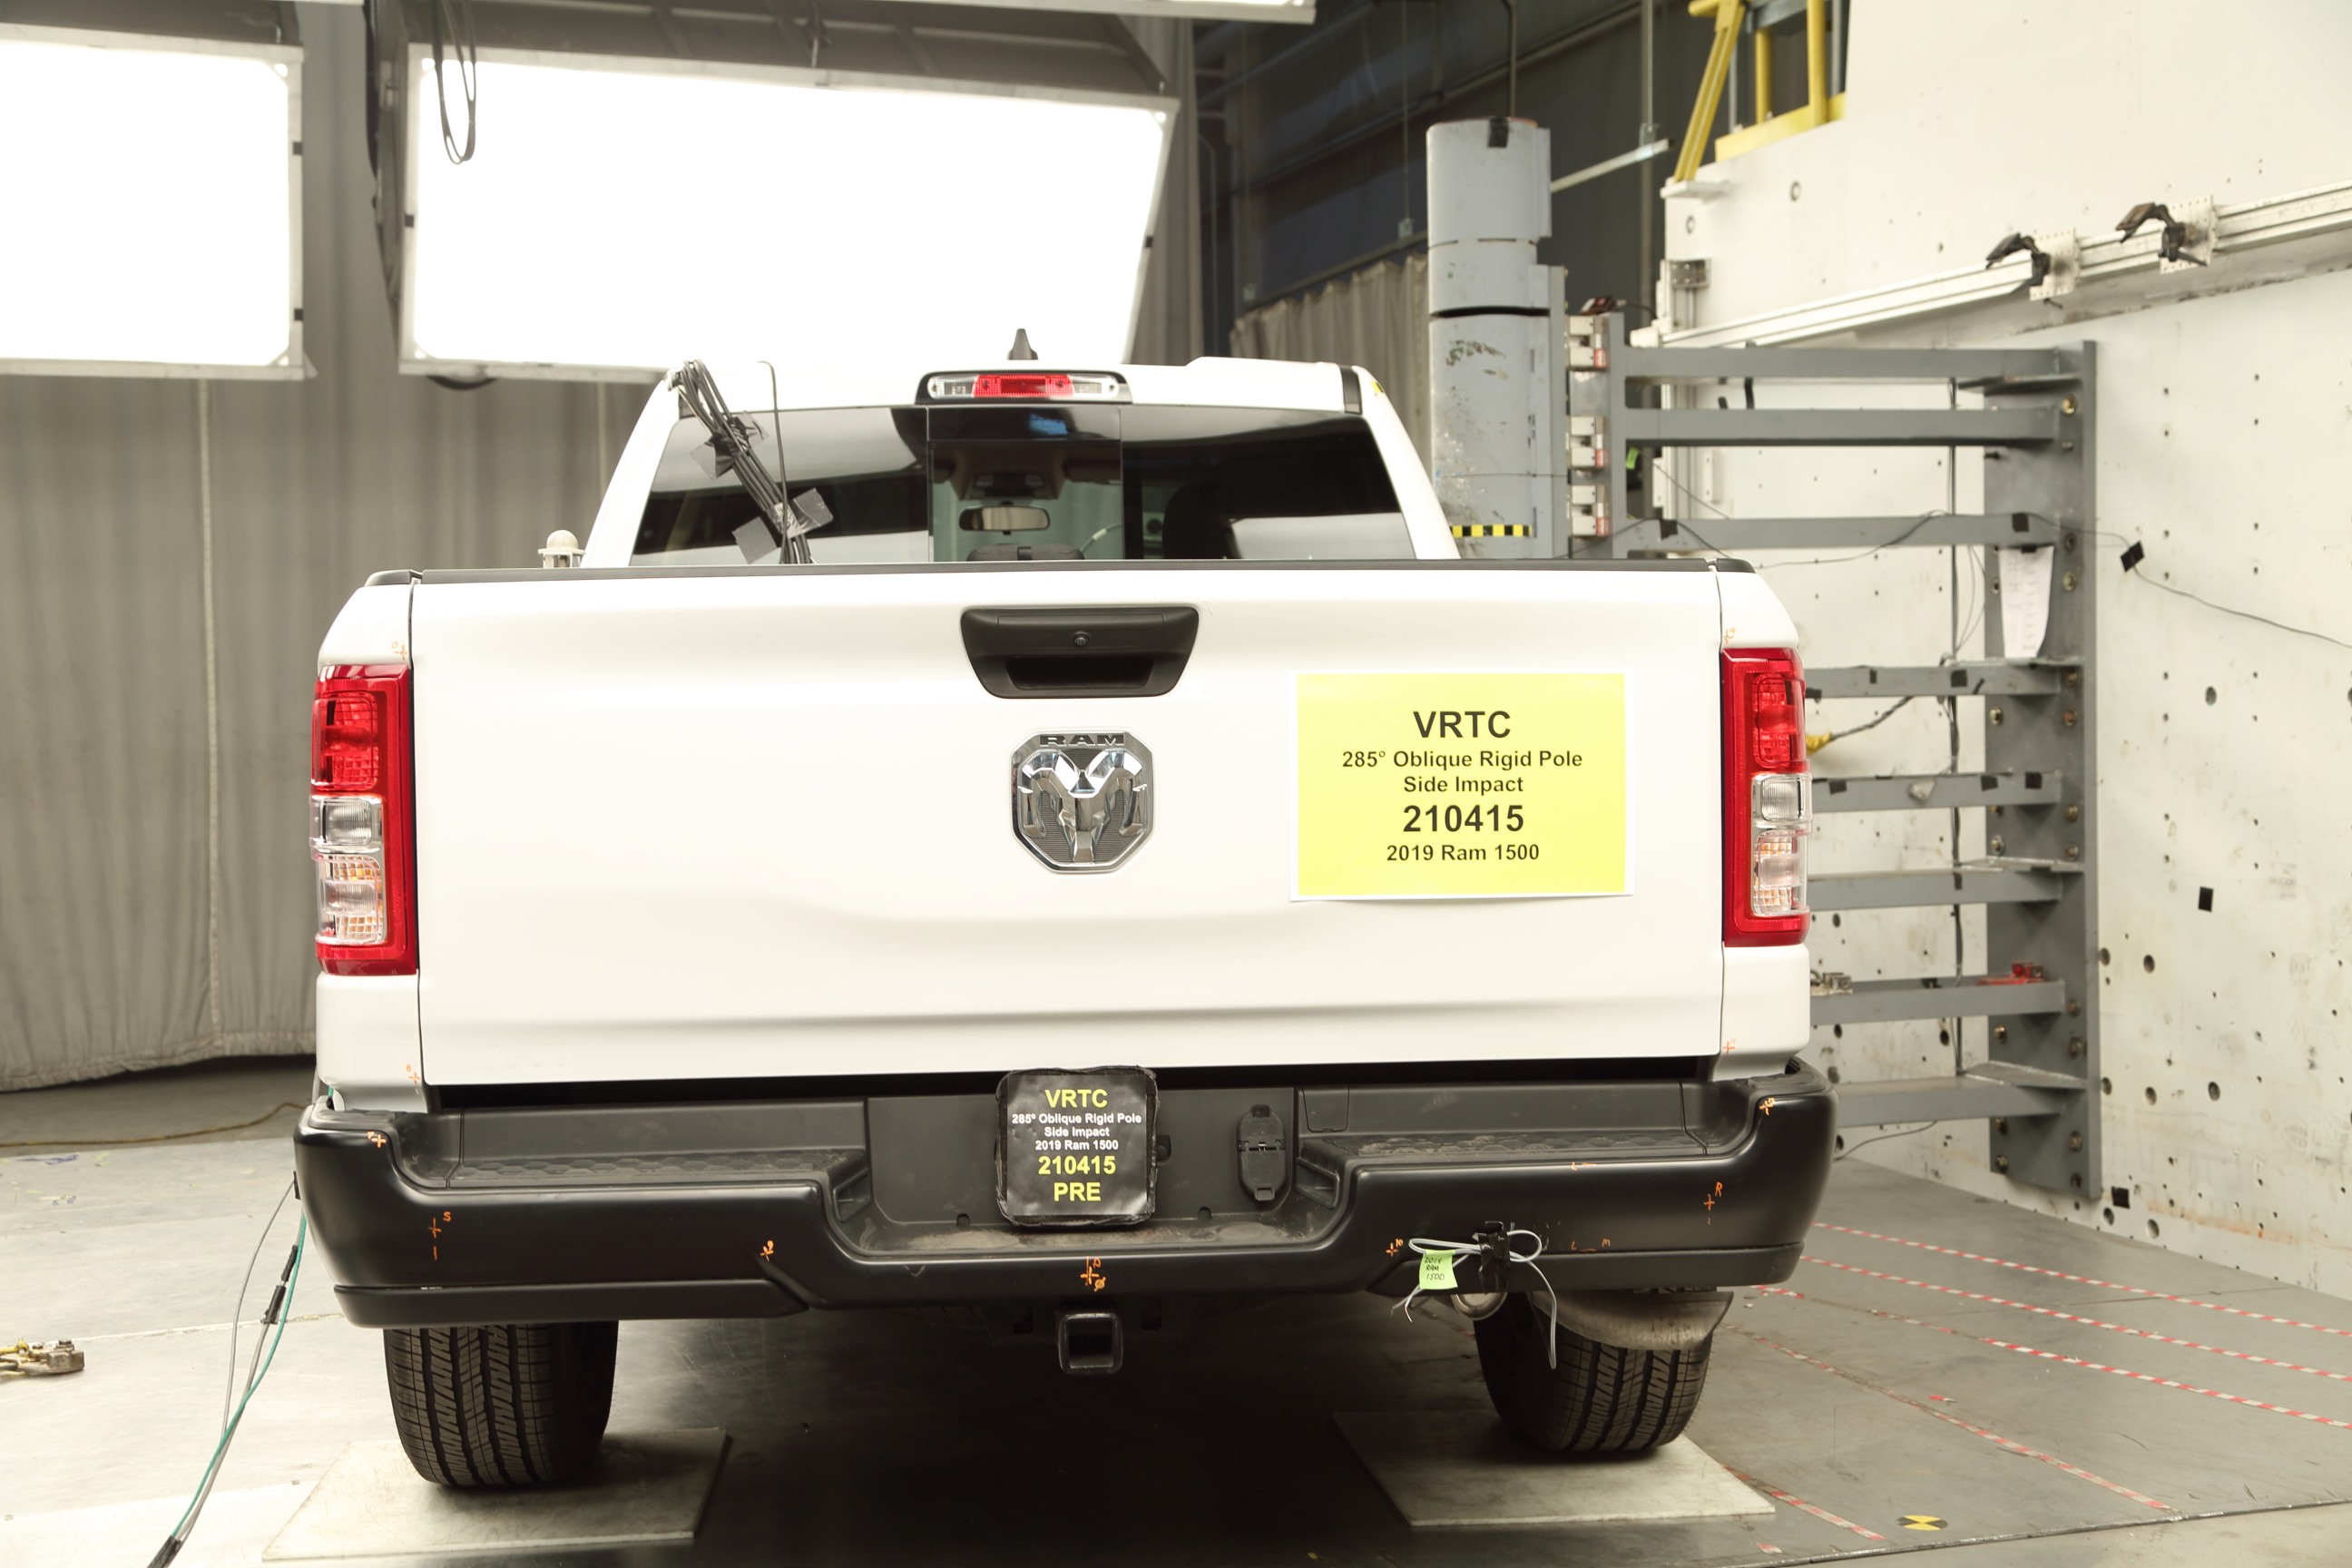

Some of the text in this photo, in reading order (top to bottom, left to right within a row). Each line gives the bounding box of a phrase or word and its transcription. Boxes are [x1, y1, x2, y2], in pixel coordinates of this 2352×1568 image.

[1413, 710, 1511, 739] VRTC
[1039, 734, 1124, 747] RAM
[1342, 750, 1583, 771] 285° Oblique Rigid Pole
[1404, 776, 1524, 796] Side Impact
[1403, 804, 1524, 833] 210415
[1387, 844, 1540, 861] 2019 Ram 1500
[1044, 1088, 1108, 1108] VRTC
[1038, 1112, 1082, 1126] Oblique
[1084, 1112, 1114, 1126] Rigid
[1117, 1112, 1142, 1123] Pole
[1044, 1126, 1110, 1140] Side Impact
[1034, 1139, 1119, 1151] 2019 Ram 1500
[1038, 1155, 1116, 1175] 210415
[1054, 1181, 1102, 1202] PRE
[443, 1210, 452, 1222] S
